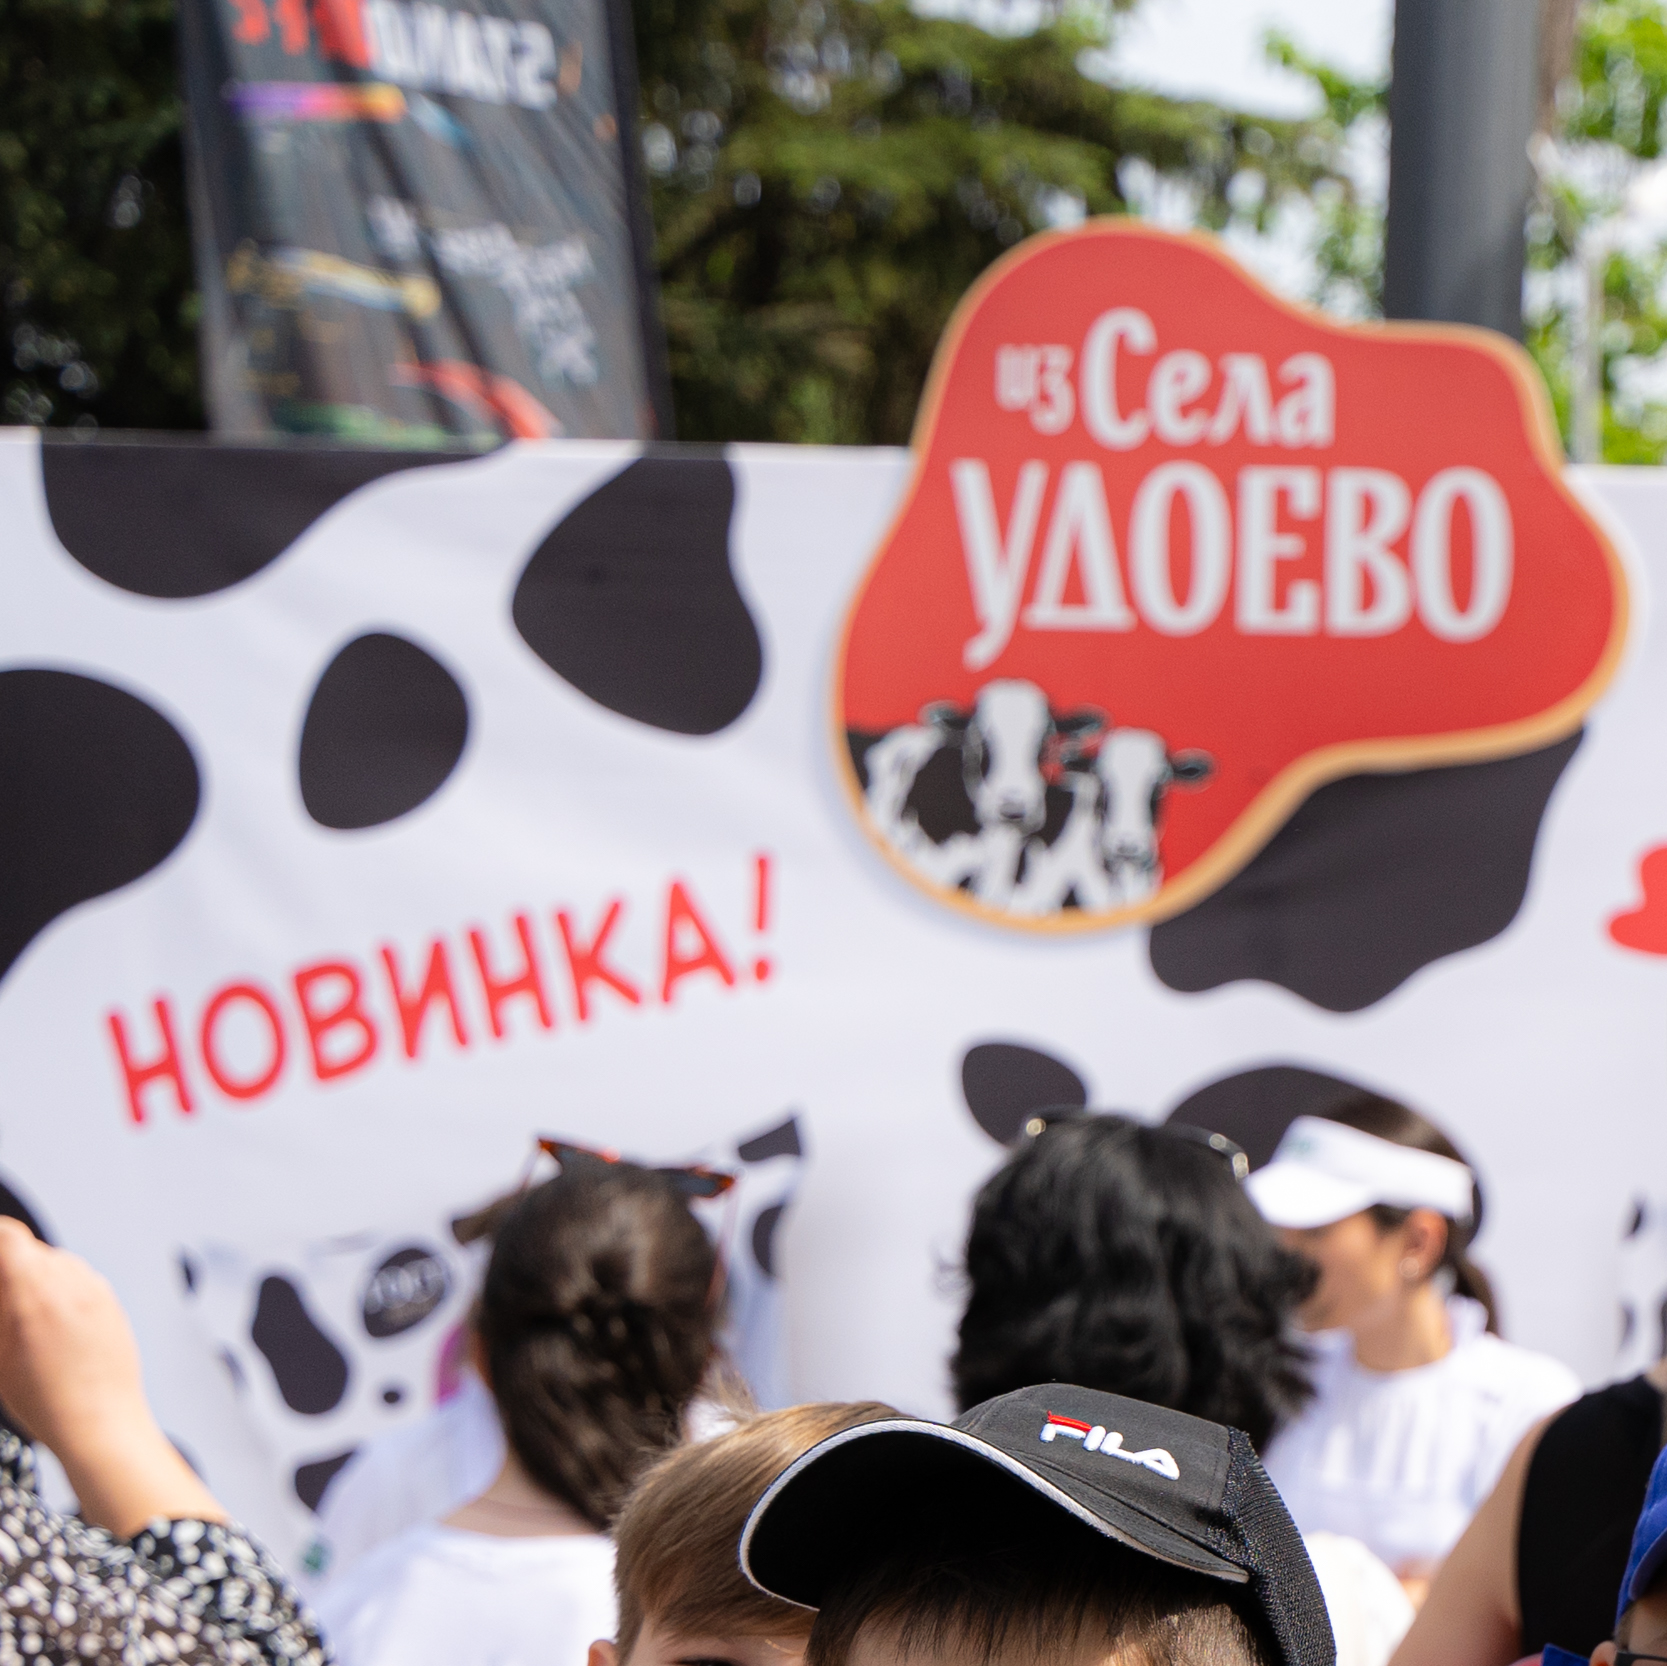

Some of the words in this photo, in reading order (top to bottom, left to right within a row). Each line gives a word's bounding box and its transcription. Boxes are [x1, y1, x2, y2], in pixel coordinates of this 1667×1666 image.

[1081, 306, 1336, 450] Села
[949, 459, 1516, 670] УДОЕВО
[107, 850, 776, 1124] НОВИНКА!
[1040, 1410, 1180, 1481] FILA
